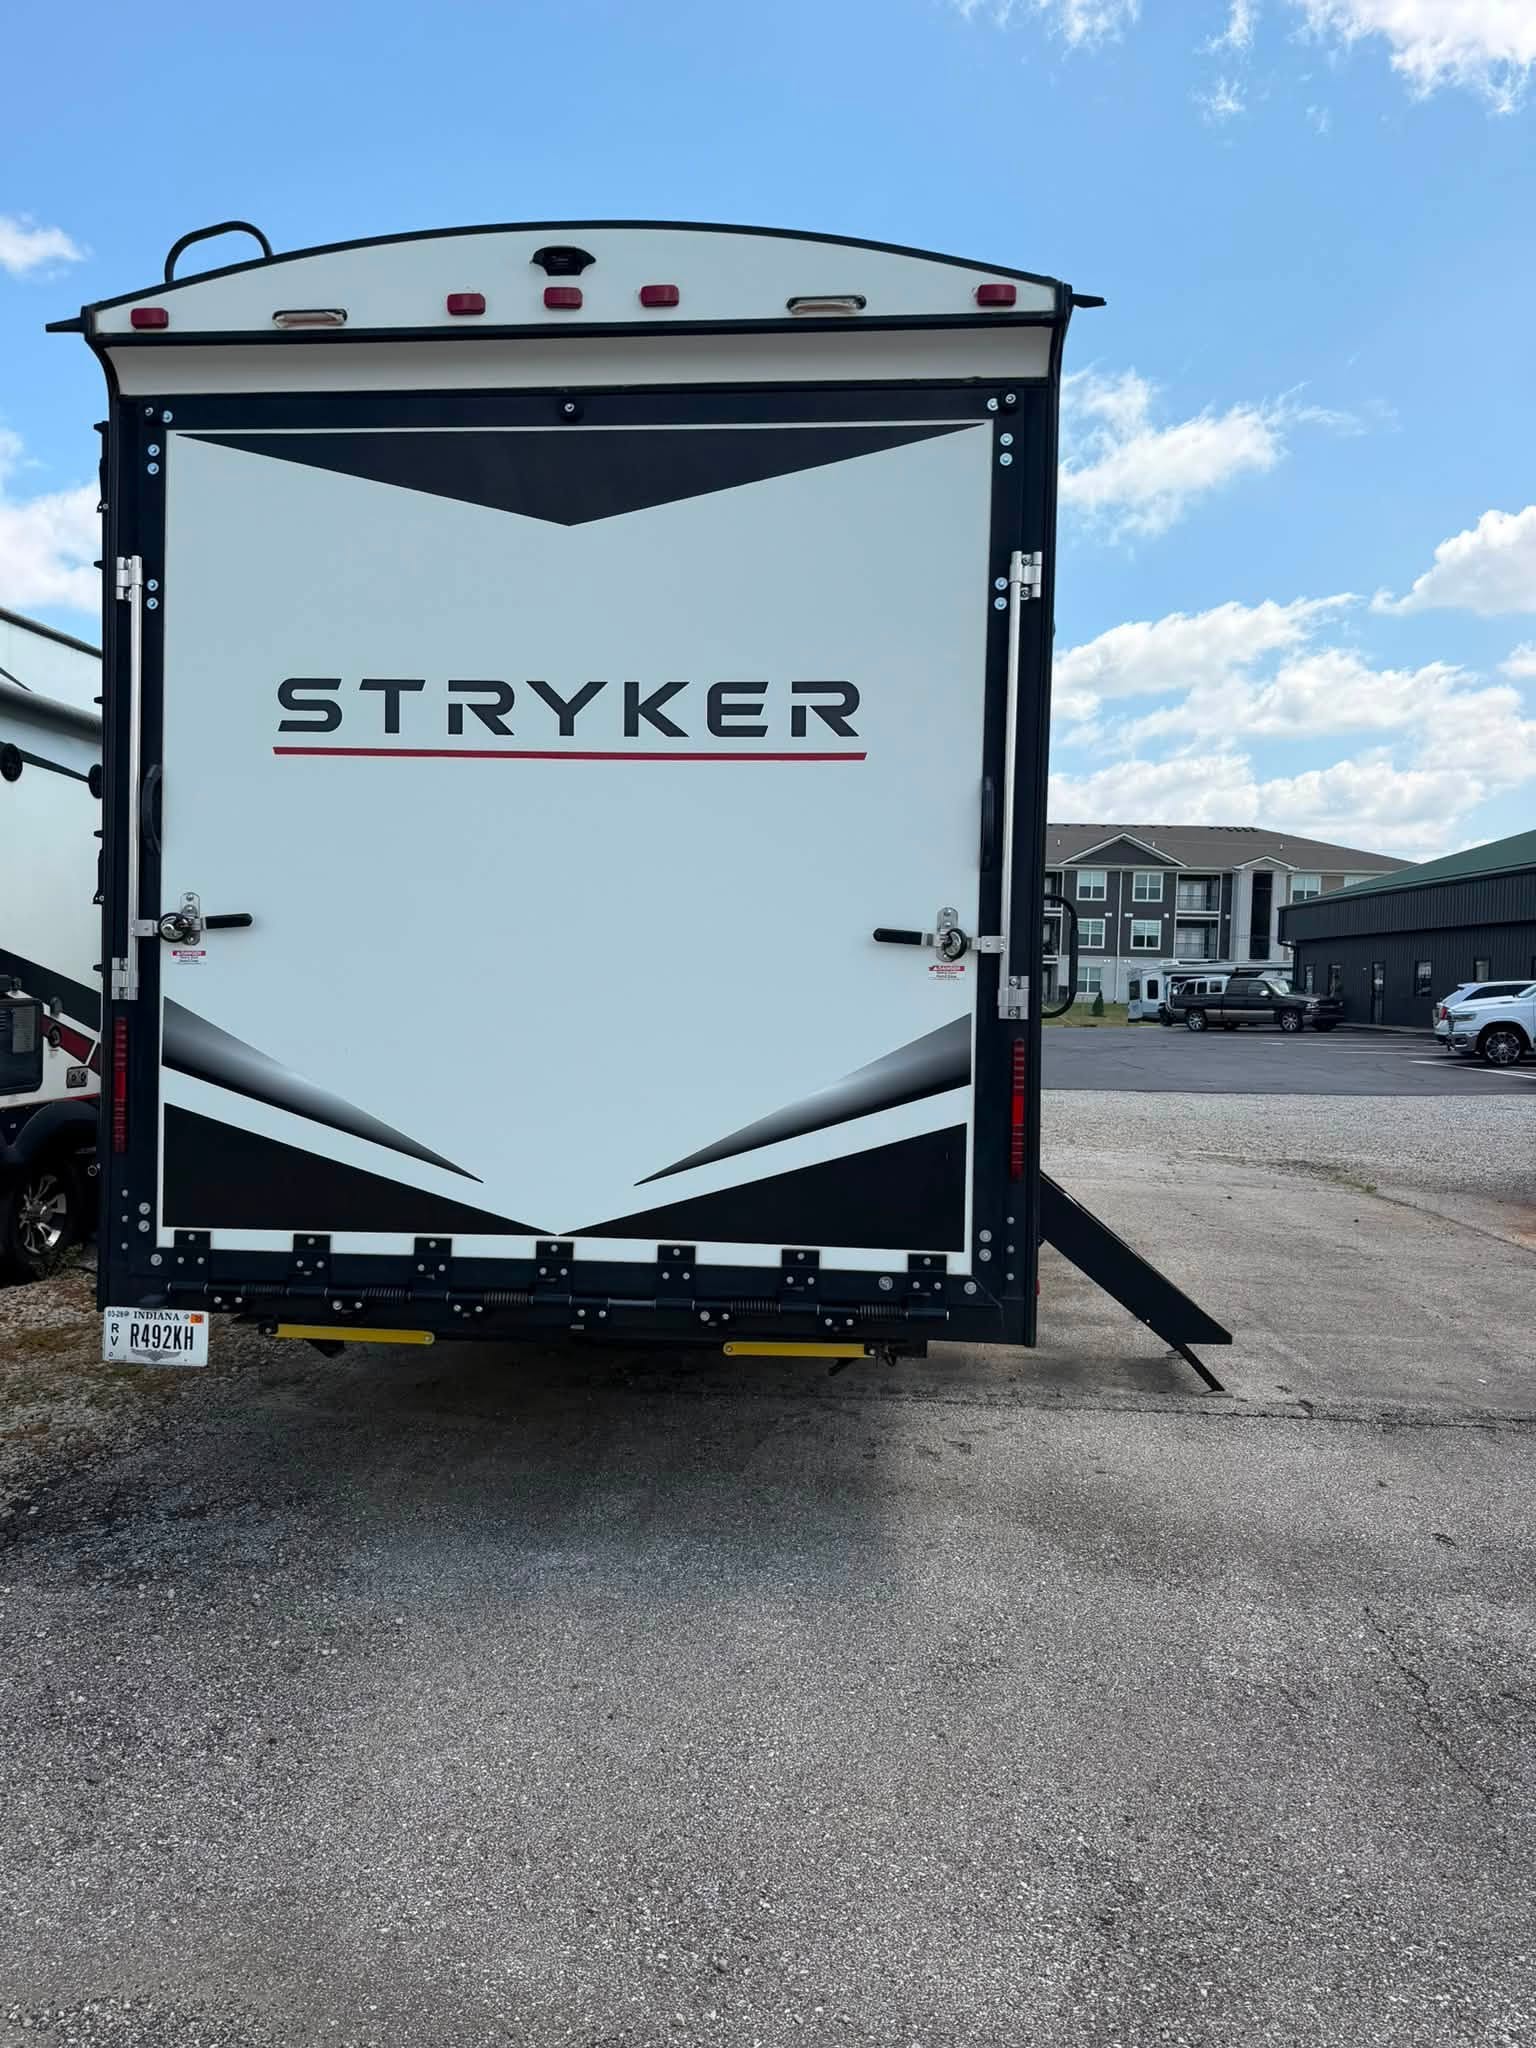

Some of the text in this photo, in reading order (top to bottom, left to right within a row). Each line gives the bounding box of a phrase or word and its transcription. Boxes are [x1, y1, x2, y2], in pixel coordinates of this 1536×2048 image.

[277, 678, 860, 737] STRYKER
[133, 1311, 180, 1320] INDIANA
[130, 1323, 194, 1350] R492KH
